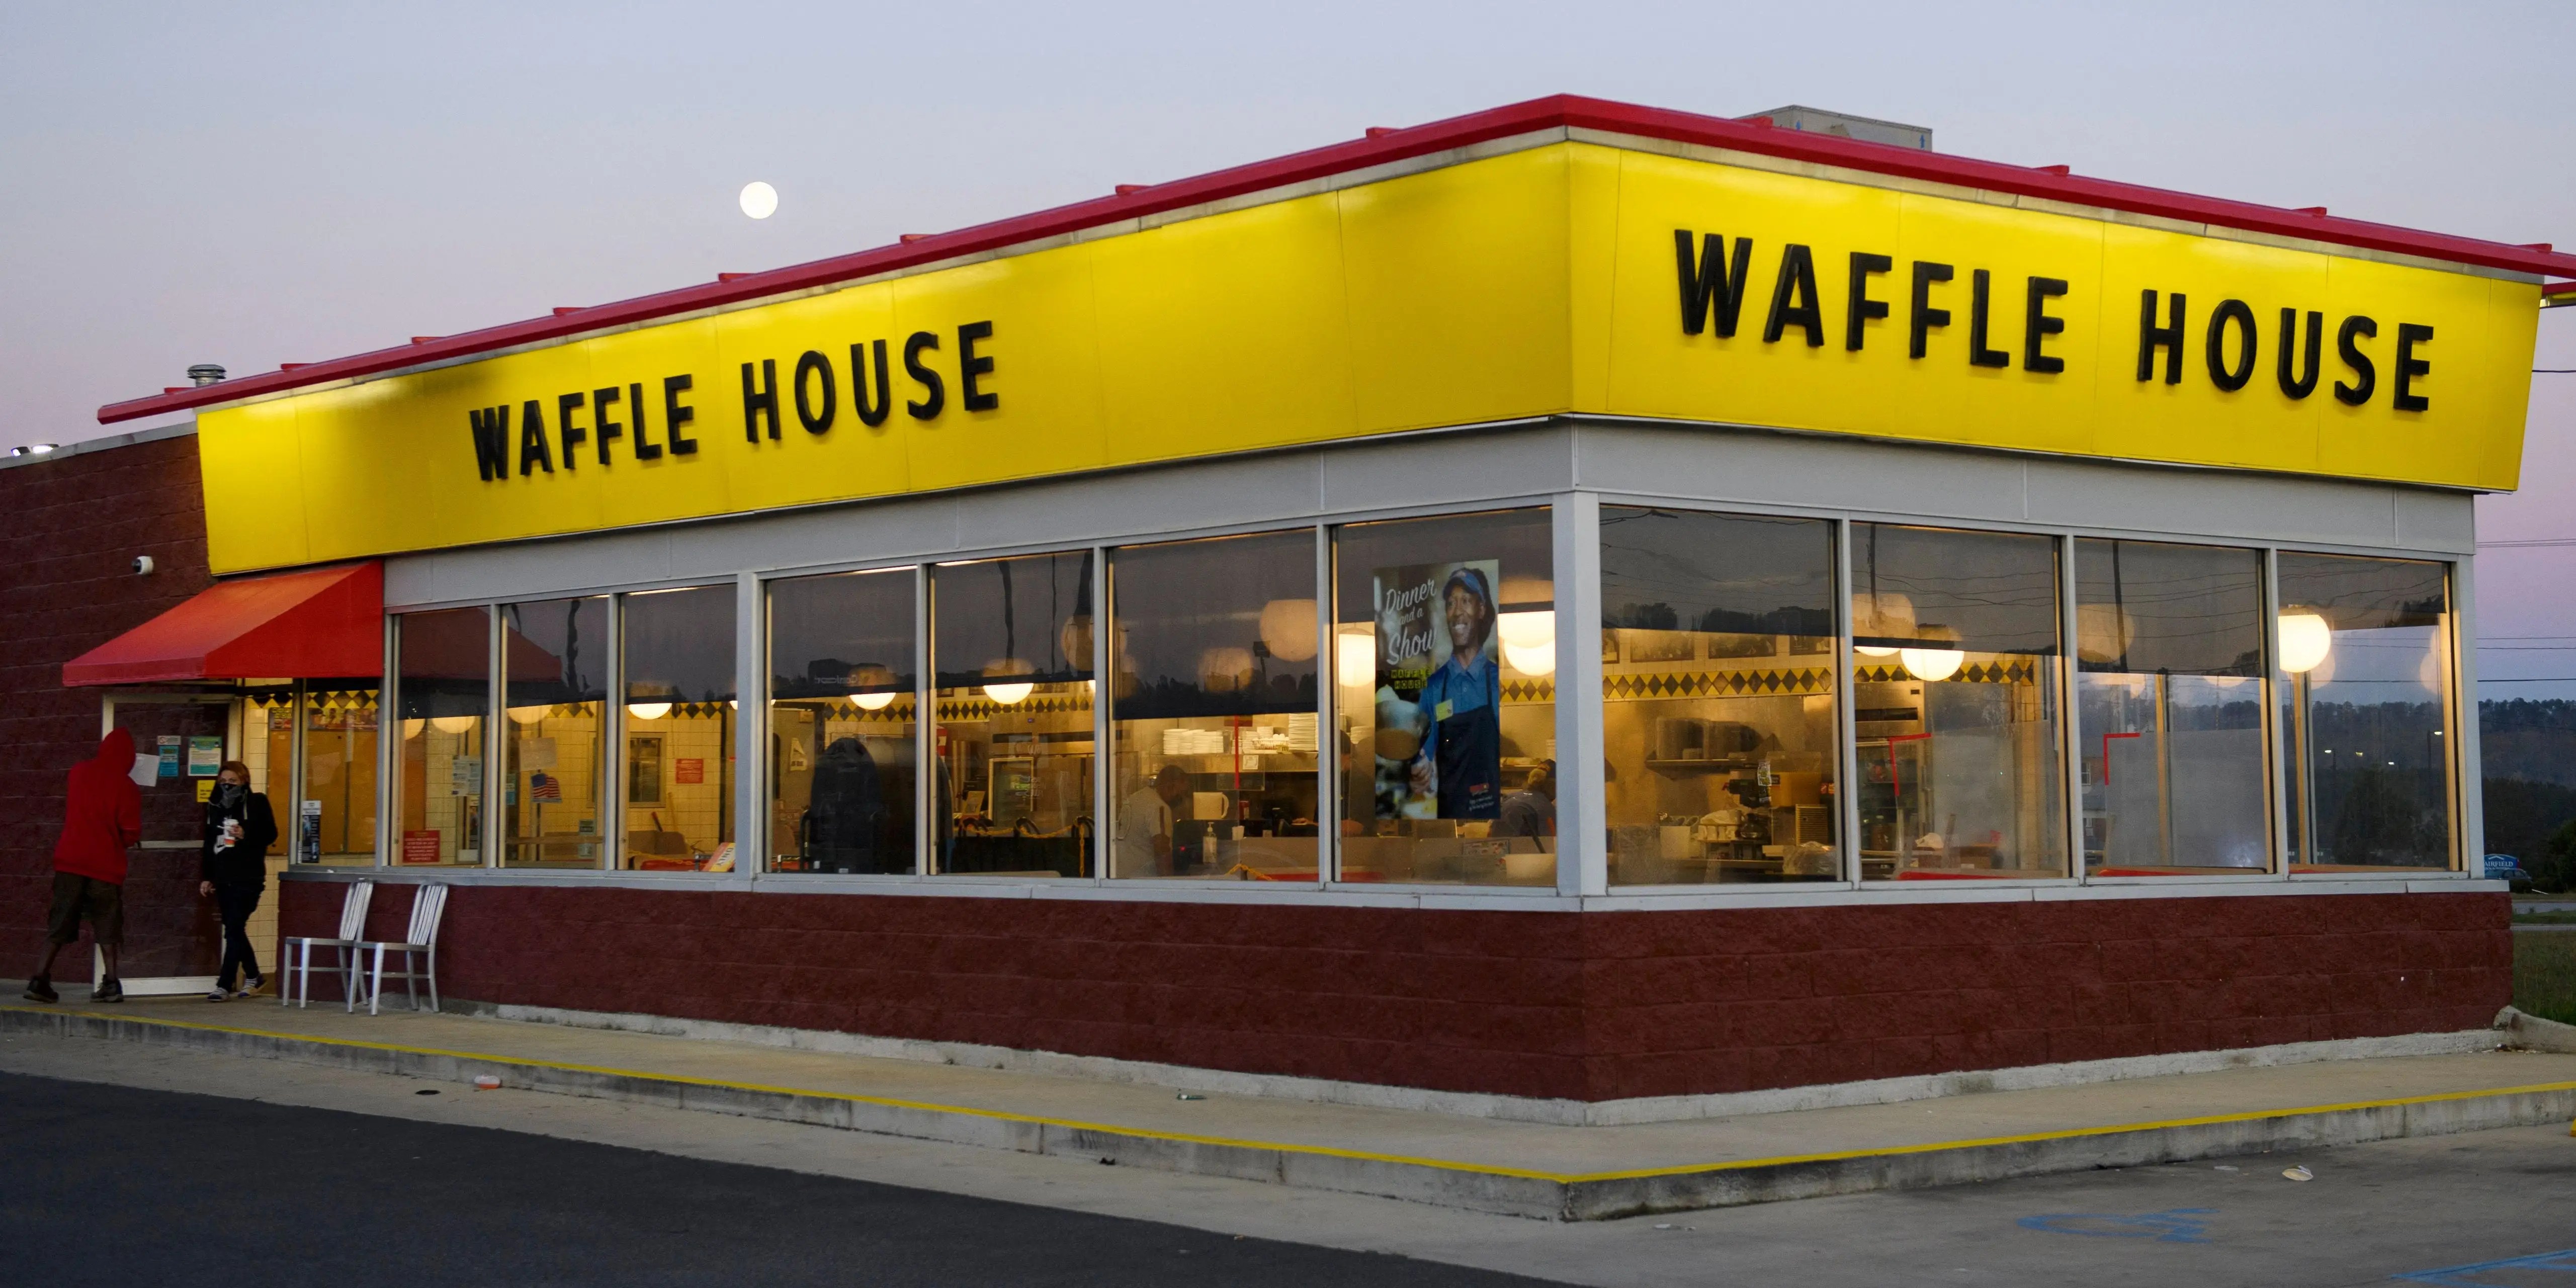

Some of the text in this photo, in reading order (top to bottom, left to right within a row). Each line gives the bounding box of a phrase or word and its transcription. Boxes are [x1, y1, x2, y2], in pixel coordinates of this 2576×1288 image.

[1674, 229, 2434, 413] WAFFLE HOUSE
[469, 320, 999, 482] WAFFLE HOUSE
[1386, 578, 1437, 614] Dinner
[1400, 606, 1424, 625] and a
[1387, 626, 1437, 665] Show
[1391, 668, 1430, 678] WAFFLE
[1395, 679, 1427, 690] HOUSE
